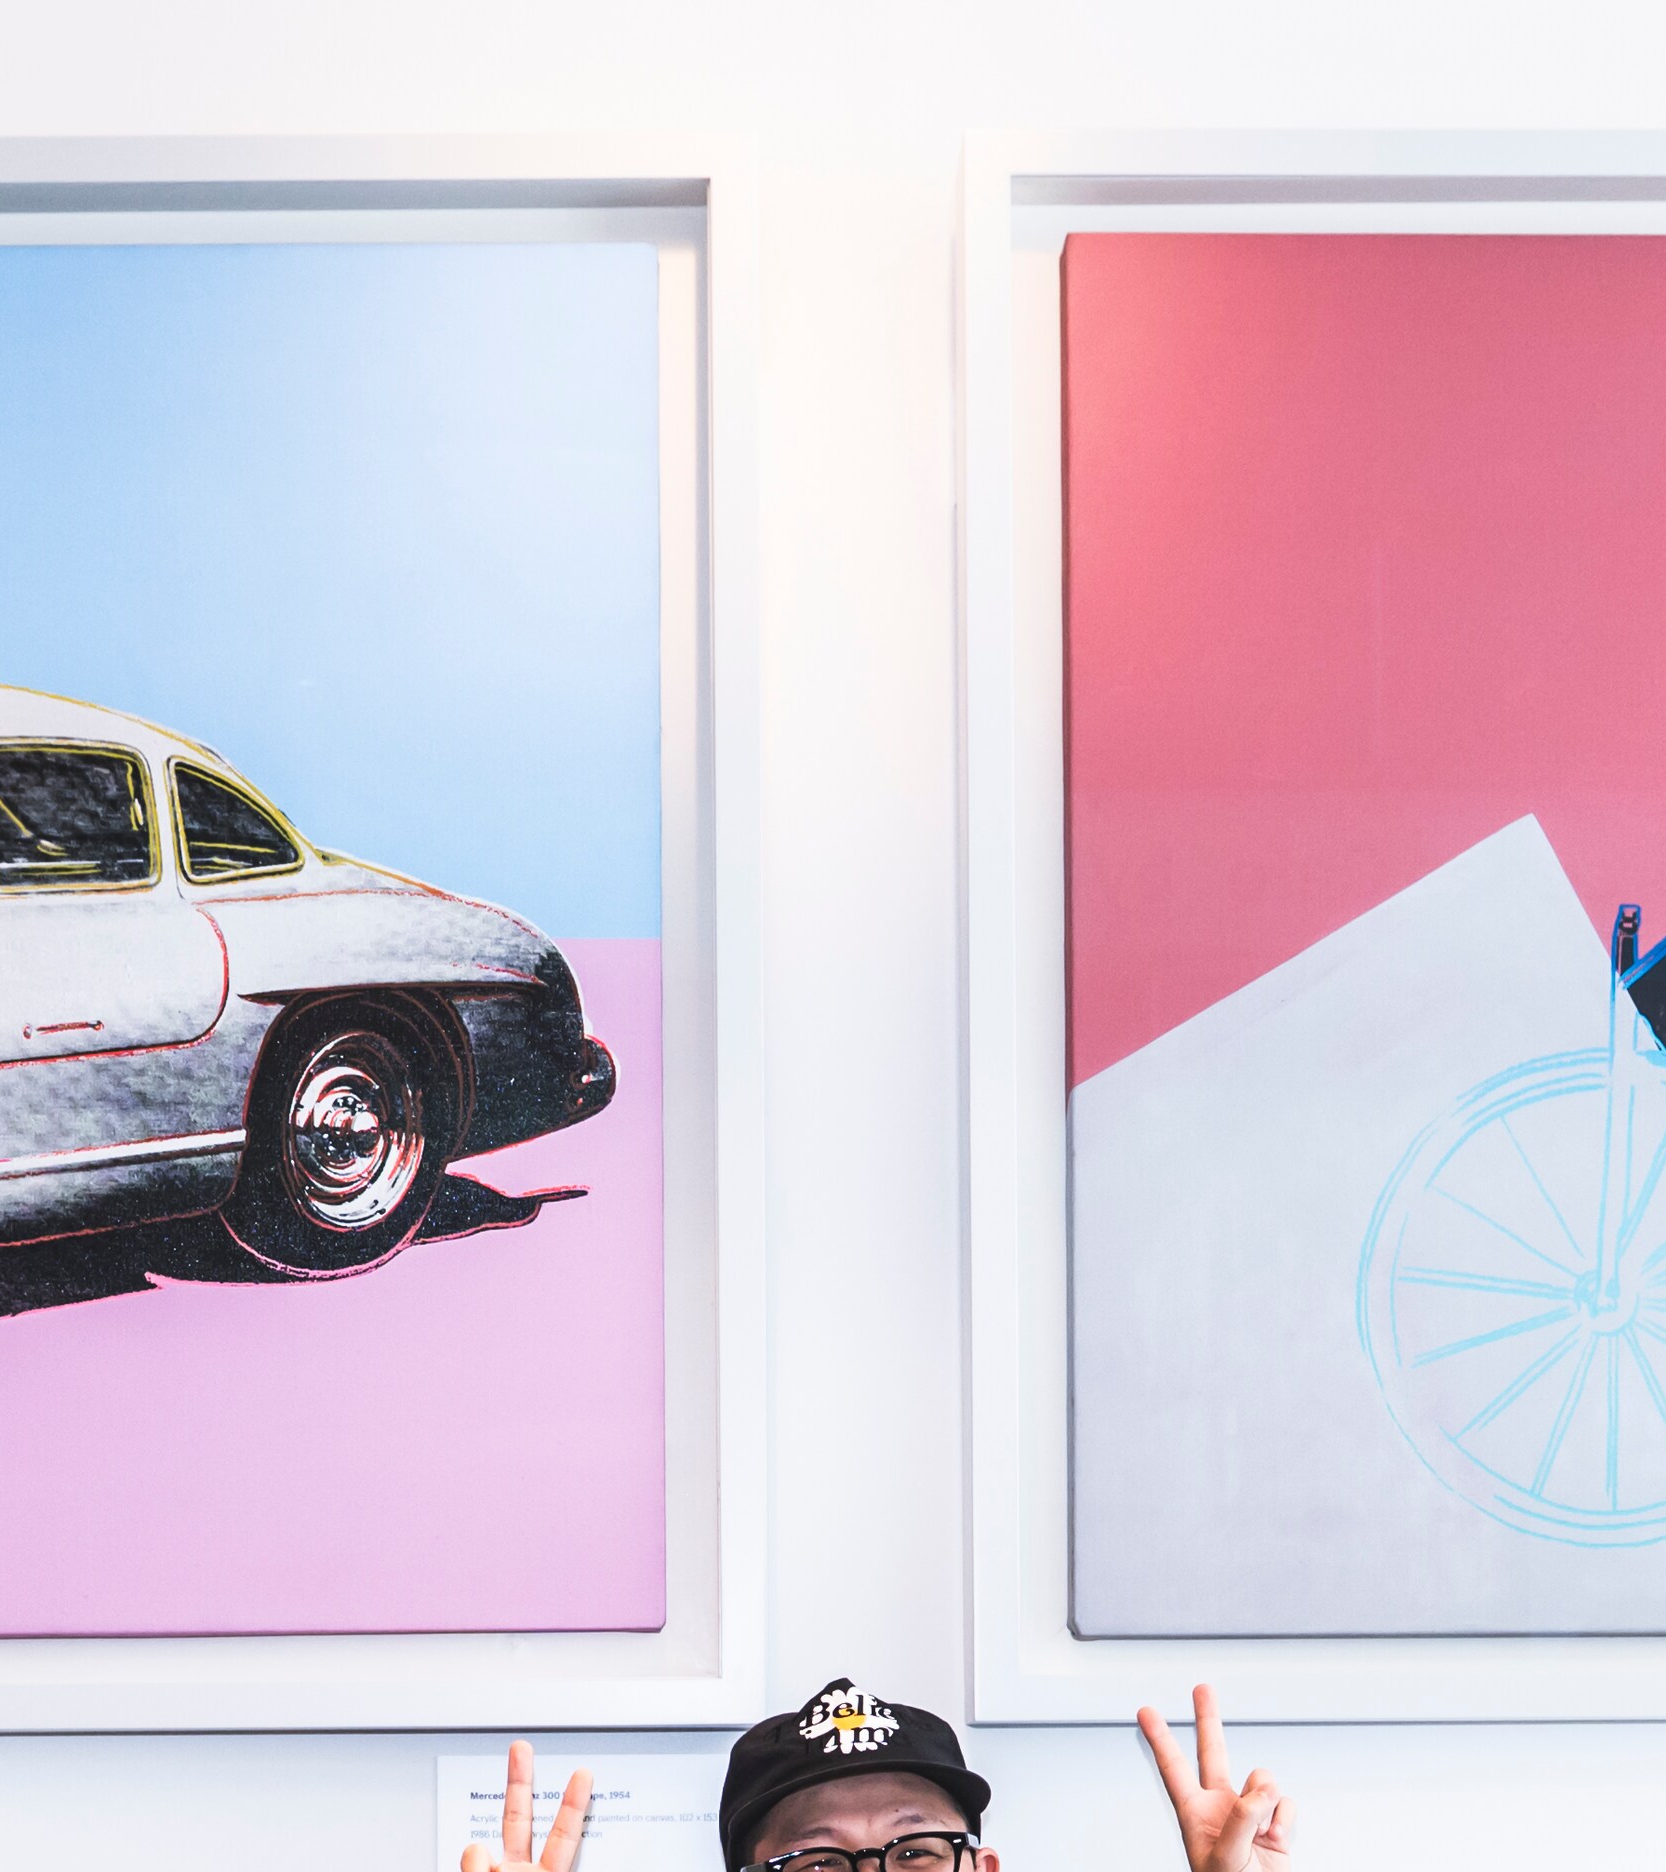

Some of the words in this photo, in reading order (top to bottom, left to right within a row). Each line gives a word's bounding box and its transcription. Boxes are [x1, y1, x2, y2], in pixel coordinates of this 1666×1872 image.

[542, 1791, 560, 1800] 300
[609, 1791, 631, 1800] 1954
[470, 1814, 498, 1823] Acrylic
[598, 1814, 630, 1823] painted
[679, 1813, 694, 1822] 102
[470, 1829, 490, 1839] 1986
